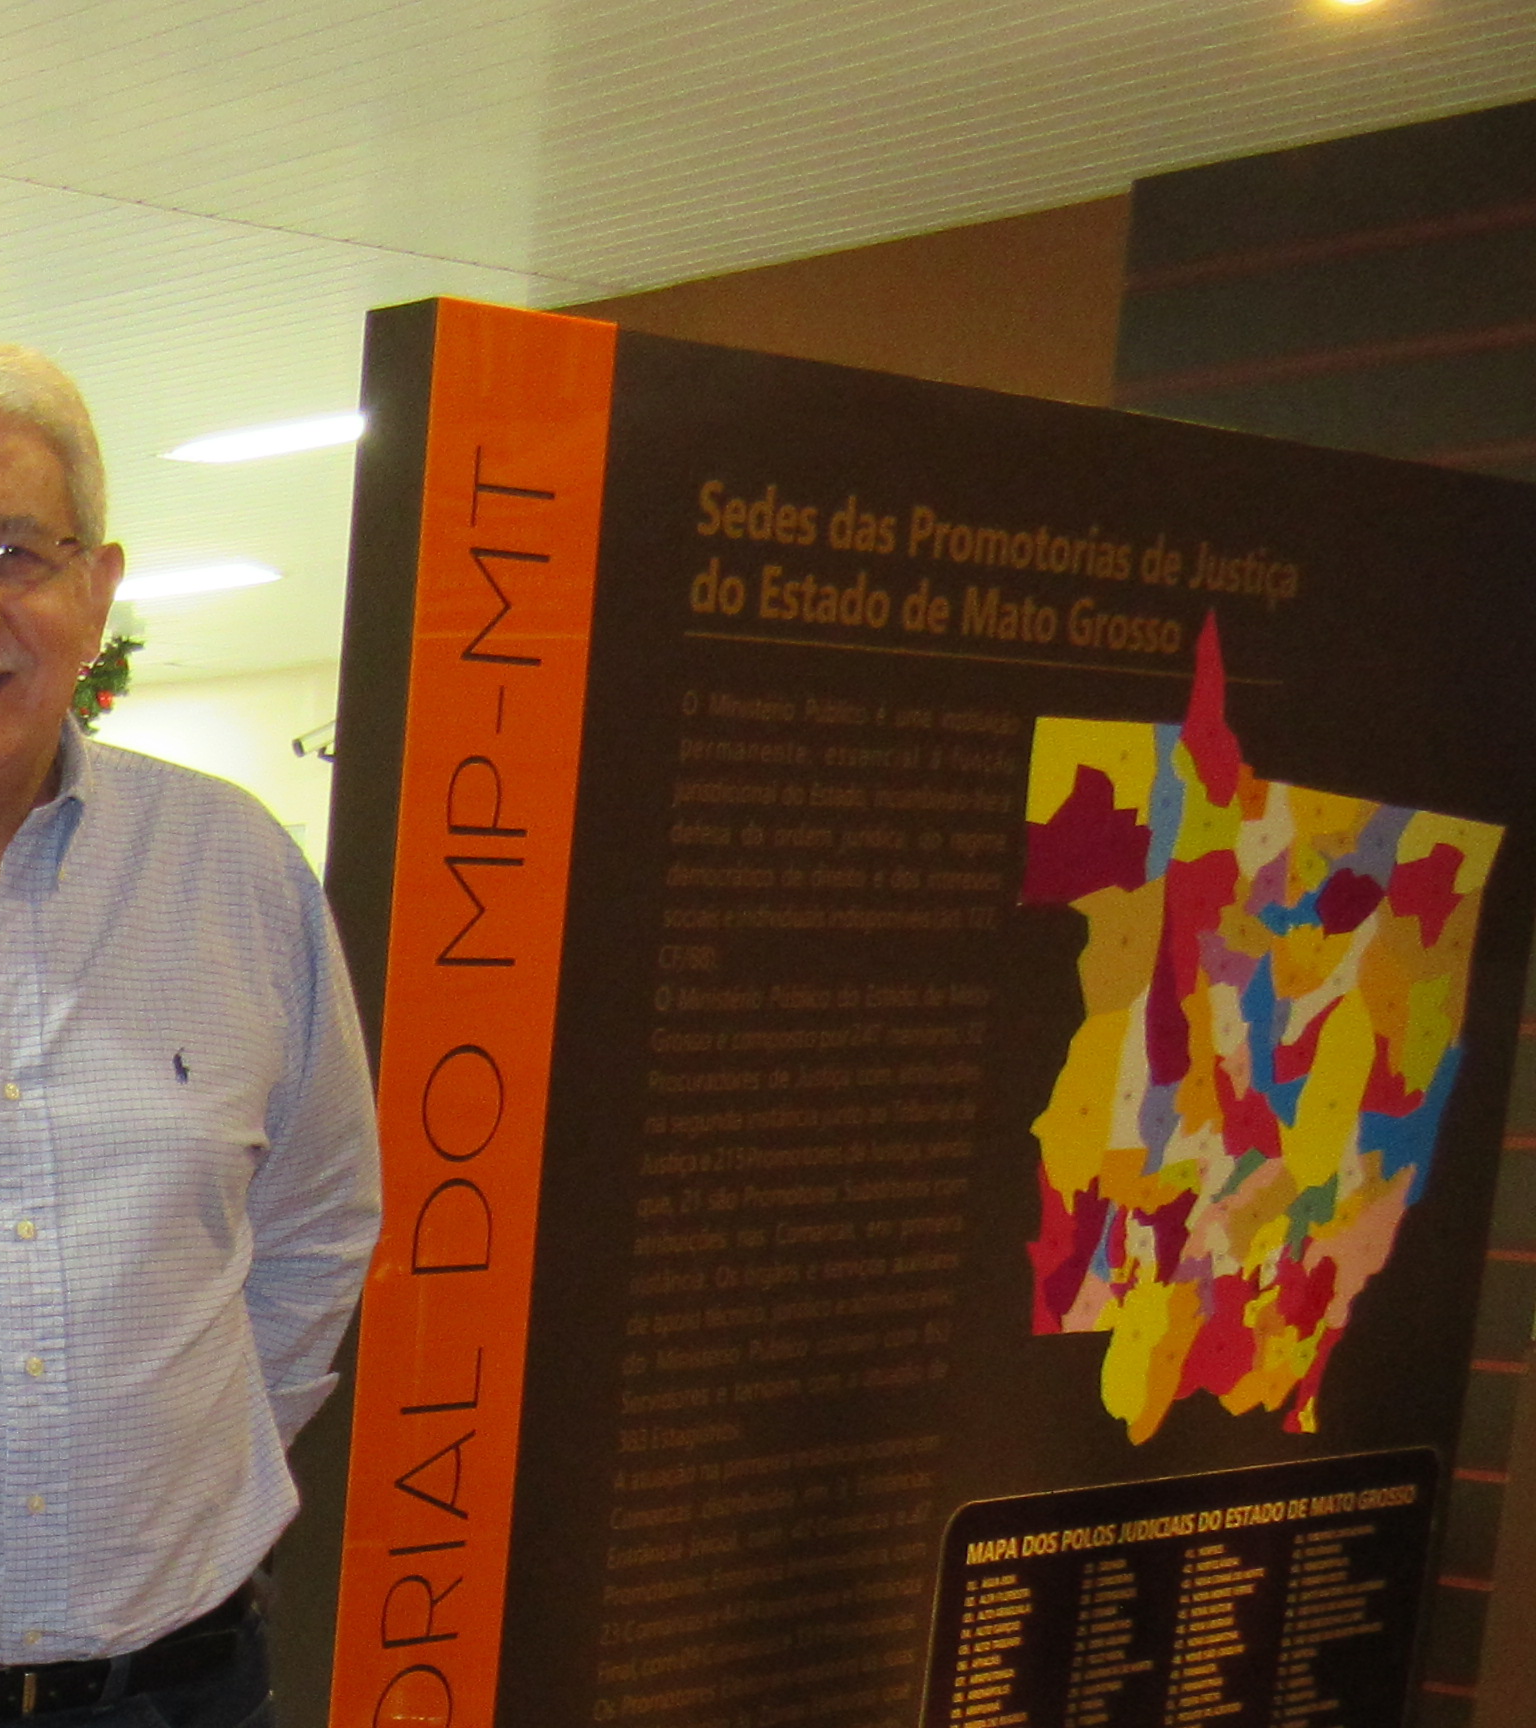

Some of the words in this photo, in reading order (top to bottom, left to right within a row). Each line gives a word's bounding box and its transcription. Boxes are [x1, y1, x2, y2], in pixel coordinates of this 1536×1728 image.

[690, 557, 745, 616] do
[760, 565, 889, 629] Estado
[903, 579, 949, 633] de
[963, 586, 1057, 643] Mato
[1069, 597, 1180, 653] Grosso
[697, 479, 817, 546] Sedes
[830, 494, 896, 554] das
[909, 505, 1131, 580] Promotorias
[1142, 535, 1181, 585] de
[1189, 542, 1298, 607] Justiça
[435, 444, 556, 968] MP-MT
[411, 1043, 505, 1277] DO
[966, 1537, 1018, 1565] MAPA
[1022, 1531, 1059, 1558] DOS
[1061, 1524, 1115, 1551] POLOS
[1197, 1509, 1223, 1532] DO
[1224, 1501, 1285, 1528] ESTADO
[1286, 1498, 1310, 1519] DE
